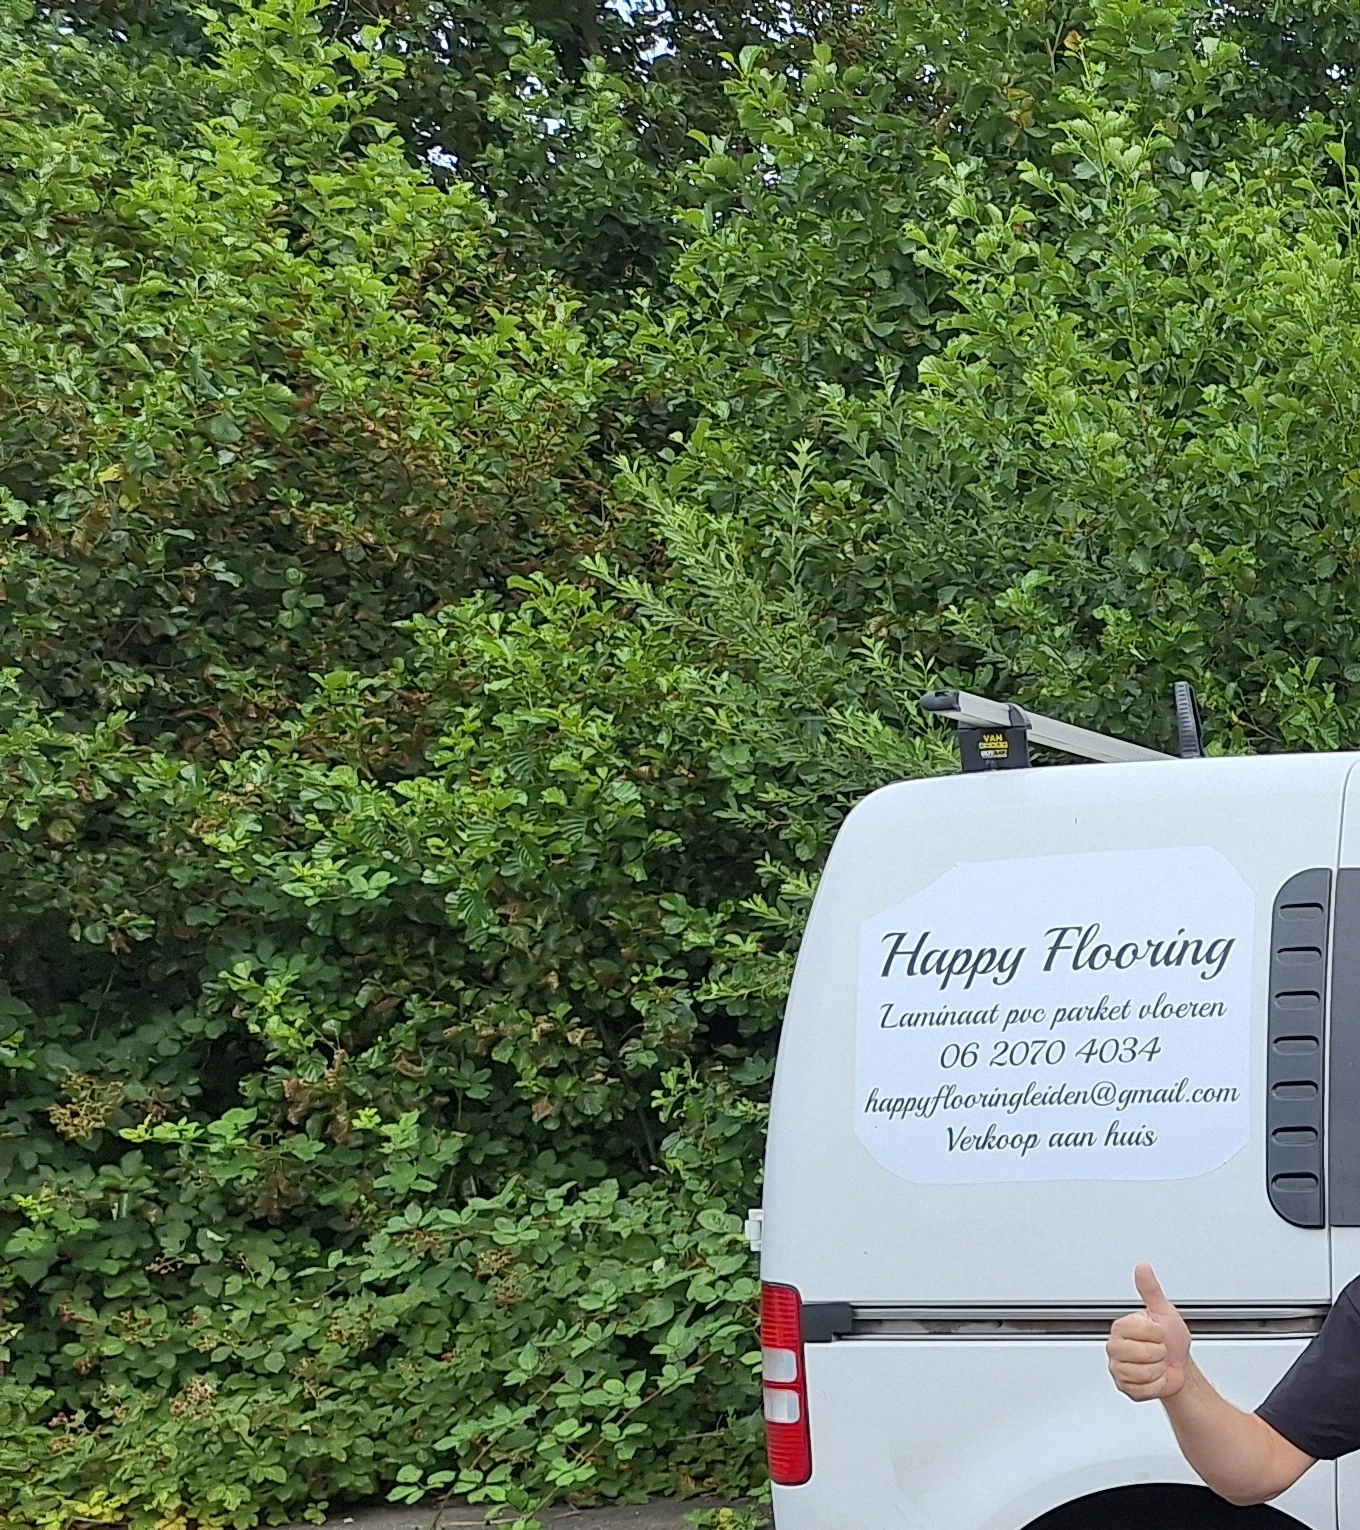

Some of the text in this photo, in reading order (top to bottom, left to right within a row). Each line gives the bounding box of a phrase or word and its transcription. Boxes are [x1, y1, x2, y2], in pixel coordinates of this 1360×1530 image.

[982, 733, 1003, 742] VAN
[880, 923, 1238, 991] Happy Flooring
[879, 992, 1228, 1032] Laminaat pvc parket vloeren
[939, 1036, 1162, 1069] 06 2070 4034
[863, 1077, 1240, 1121] happyflooringleiden@gmail.com
[946, 1120, 1158, 1157] Verkoop aan huis
